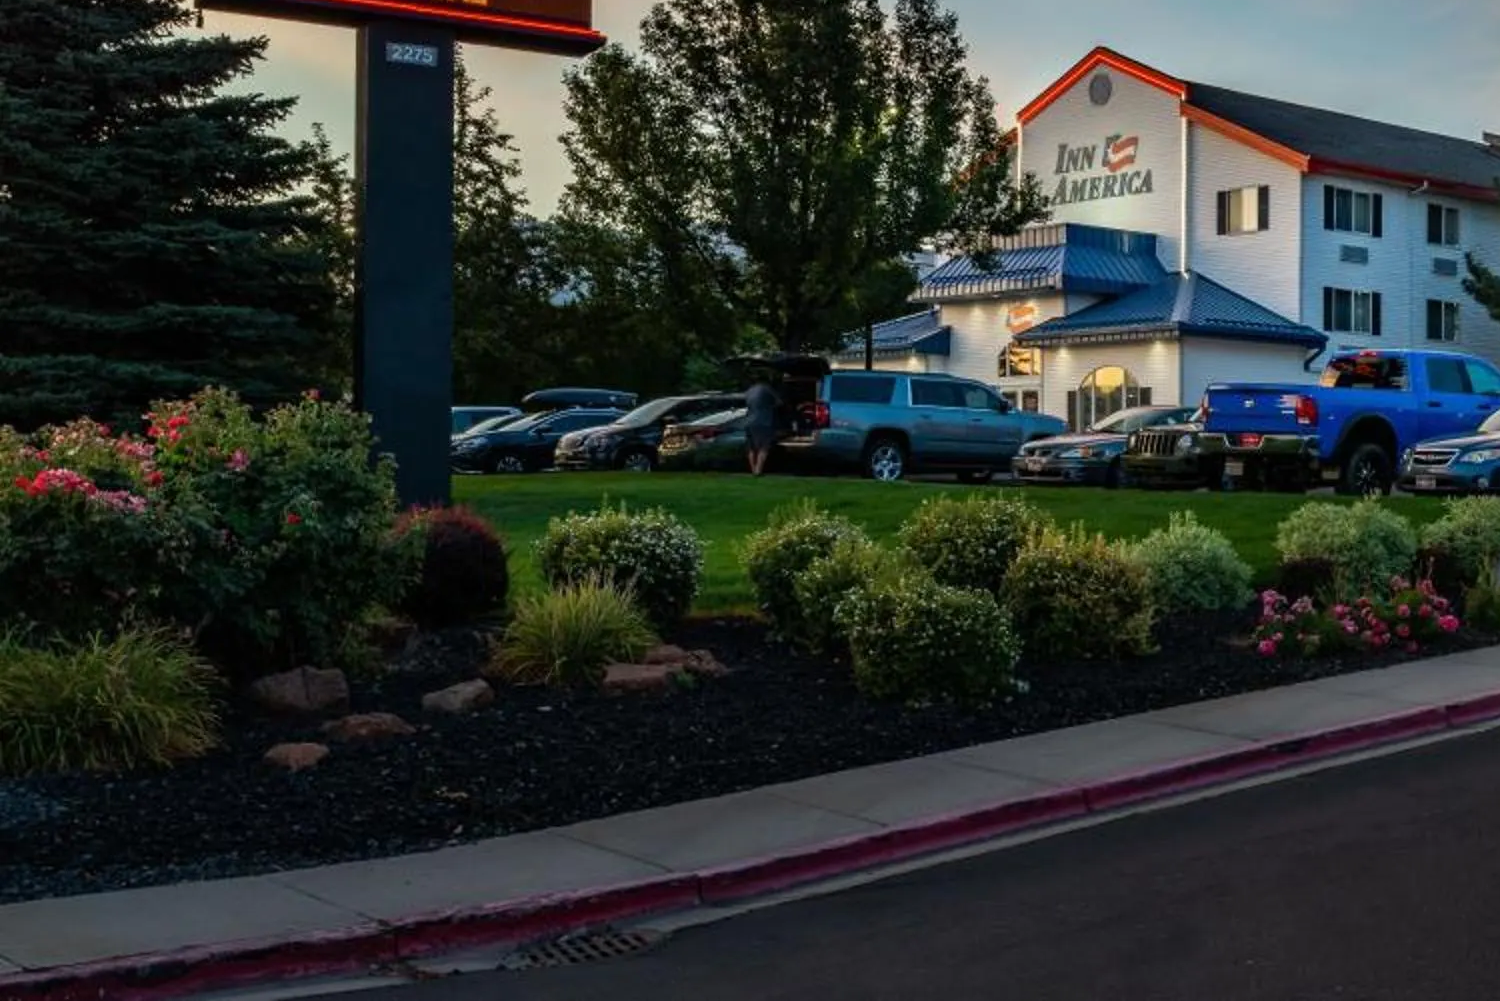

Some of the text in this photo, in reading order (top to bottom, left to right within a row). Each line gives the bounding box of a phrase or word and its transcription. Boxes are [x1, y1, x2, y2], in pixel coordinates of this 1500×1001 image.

[391, 45, 433, 64] 2275
[1055, 143, 1097, 174] INN
[1050, 168, 1153, 205] AMERICA
